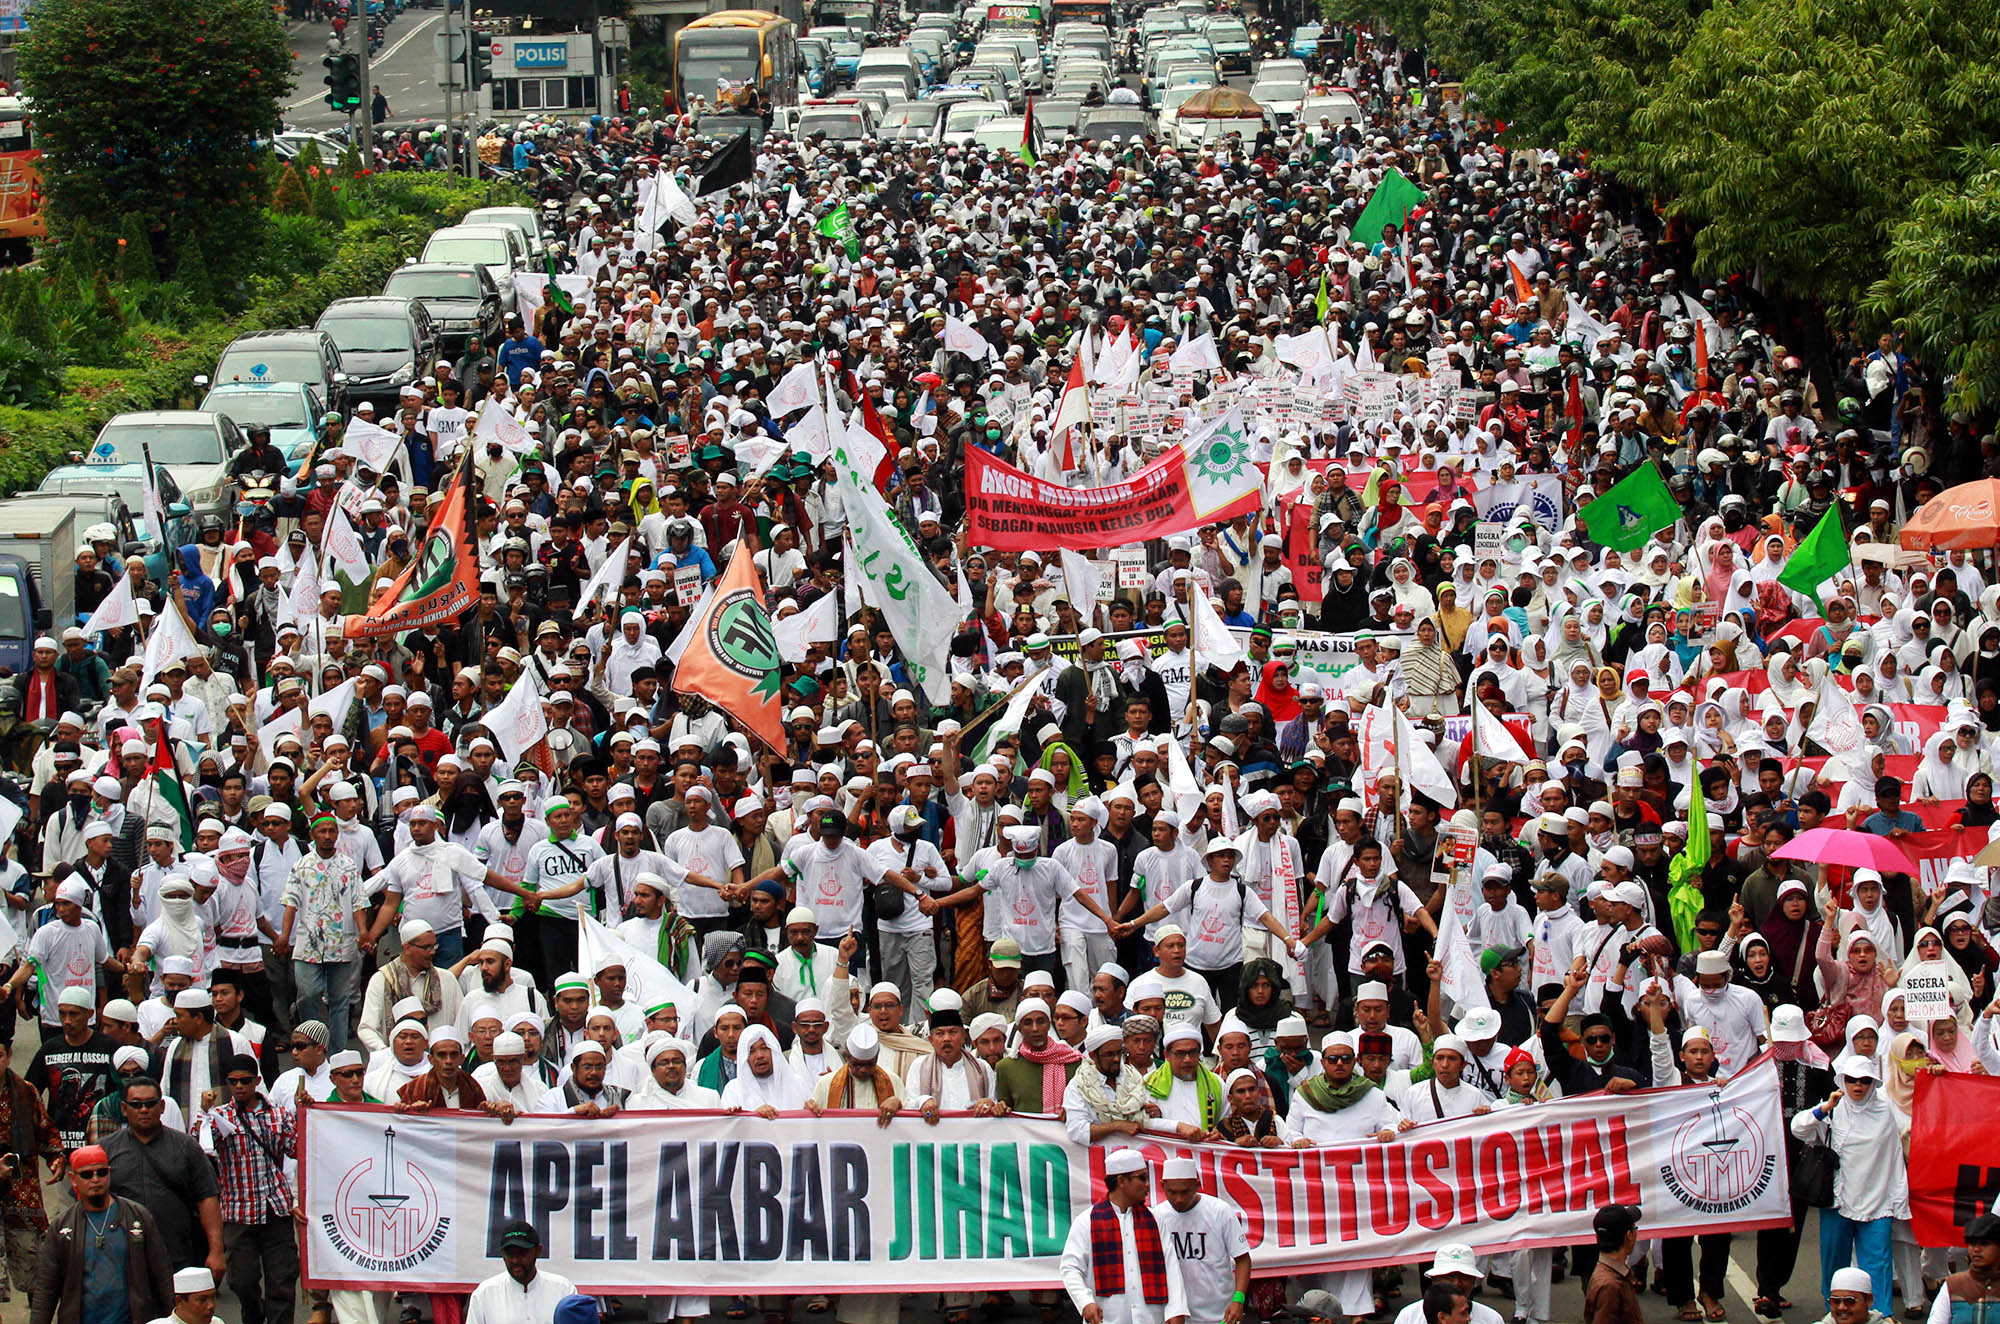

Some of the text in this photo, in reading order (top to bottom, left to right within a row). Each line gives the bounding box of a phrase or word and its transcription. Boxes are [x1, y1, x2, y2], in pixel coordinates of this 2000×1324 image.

[516, 48, 565, 61] POLISI
[970, 497, 988, 512] DIA
[978, 503, 1175, 534] SEBAGAI MANUSIA KELAS DUA
[680, 583, 697, 591] AHOK
[1161, 667, 1191, 685] GMJ
[1907, 978, 1945, 989] SEGERA
[1907, 991, 1946, 1003] LENGSERKAN
[1908, 1004, 1936, 1016] AHOK
[73, 1052, 81, 1064] AL
[82, 1052, 110, 1064] QASSAM
[67, 1131, 85, 1140] STOP
[1088, 1114, 1642, 1249] STITUSIONAL
[1660, 1154, 1776, 1214] GERAKAN MASYARAKAT JAKARTA
[486, 1140, 1071, 1261] APEL AKBAR JIHAD
[322, 1213, 451, 1272] GERAKAN MASYARAKAT JAKARTA
[1171, 1231, 1206, 1261] MJ
